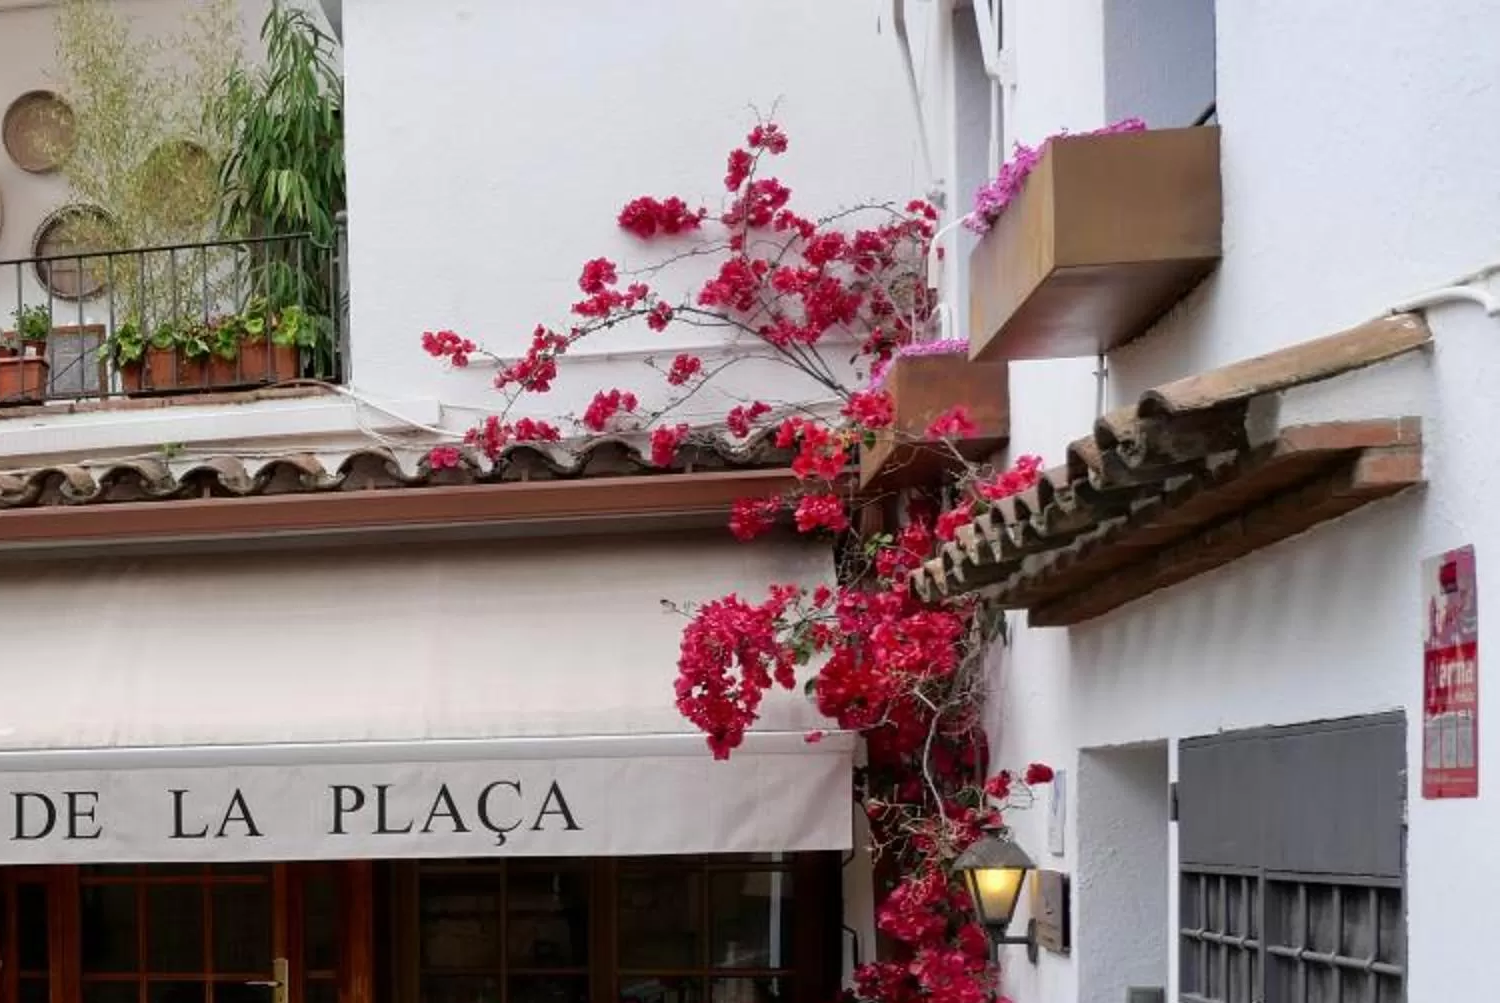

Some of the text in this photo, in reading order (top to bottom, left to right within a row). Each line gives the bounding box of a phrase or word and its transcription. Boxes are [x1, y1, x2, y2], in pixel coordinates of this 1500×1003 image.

[10, 791, 103, 841] DE
[168, 788, 264, 839] LA
[329, 780, 582, 847] PLAÇA
